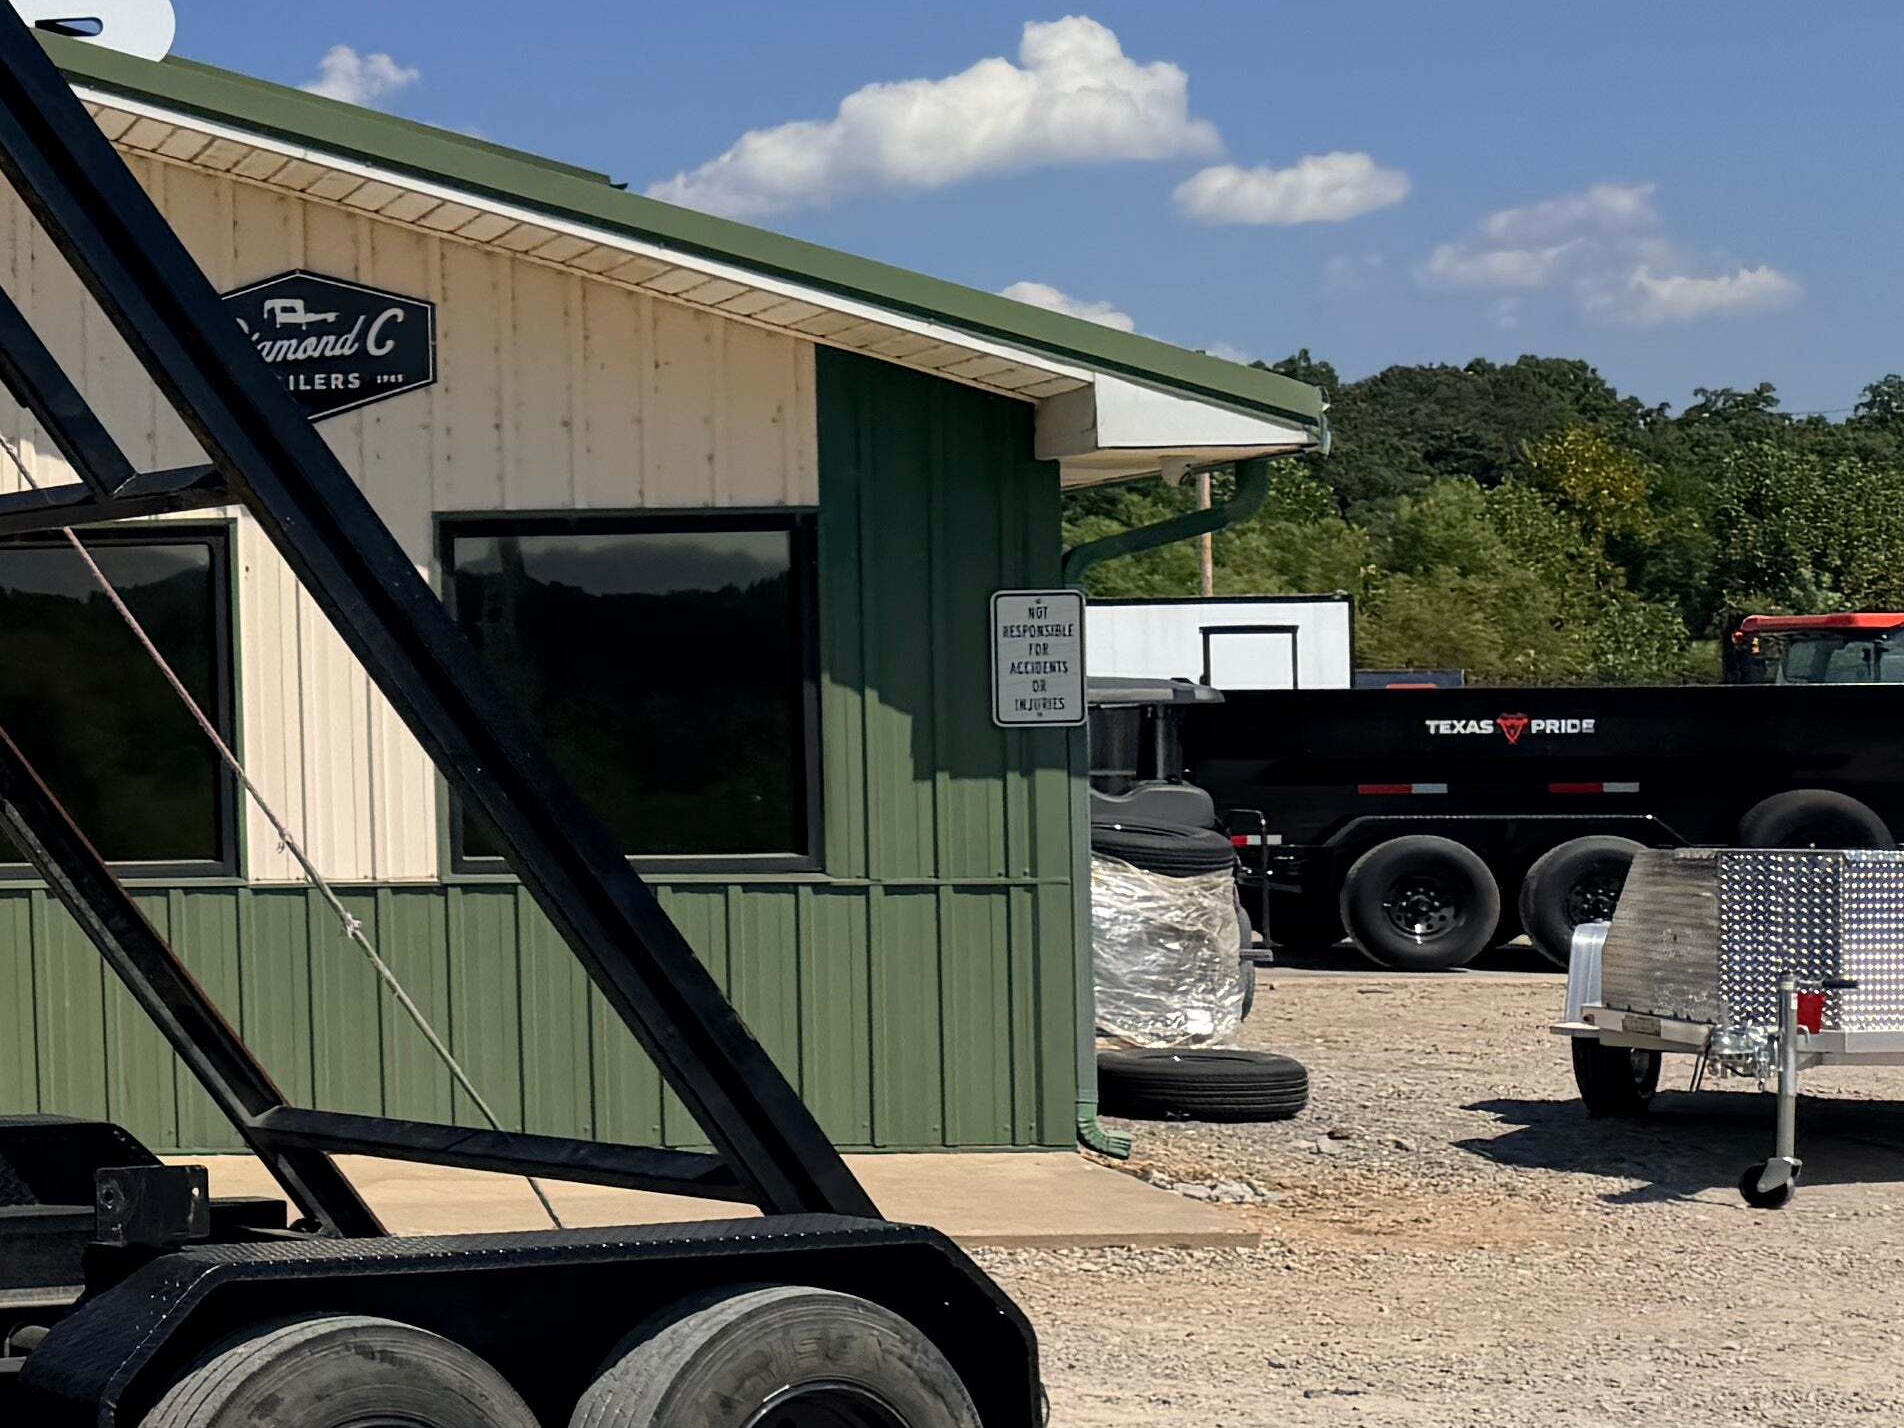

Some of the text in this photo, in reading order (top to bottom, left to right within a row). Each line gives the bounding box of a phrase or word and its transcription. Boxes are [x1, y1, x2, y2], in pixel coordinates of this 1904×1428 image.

[366, 307, 405, 357] C
[288, 373, 361, 391] ILERS
[1028, 606, 1048, 619] NOT
[1002, 623, 1075, 638] RESPONSIBLE
[1029, 643, 1049, 656] FOR
[1009, 660, 1068, 675] ACCIDENTS
[1032, 679, 1047, 692] OR
[1015, 697, 1065, 711] INJURIES
[1425, 719, 1596, 735] TEXAS PRIDE
